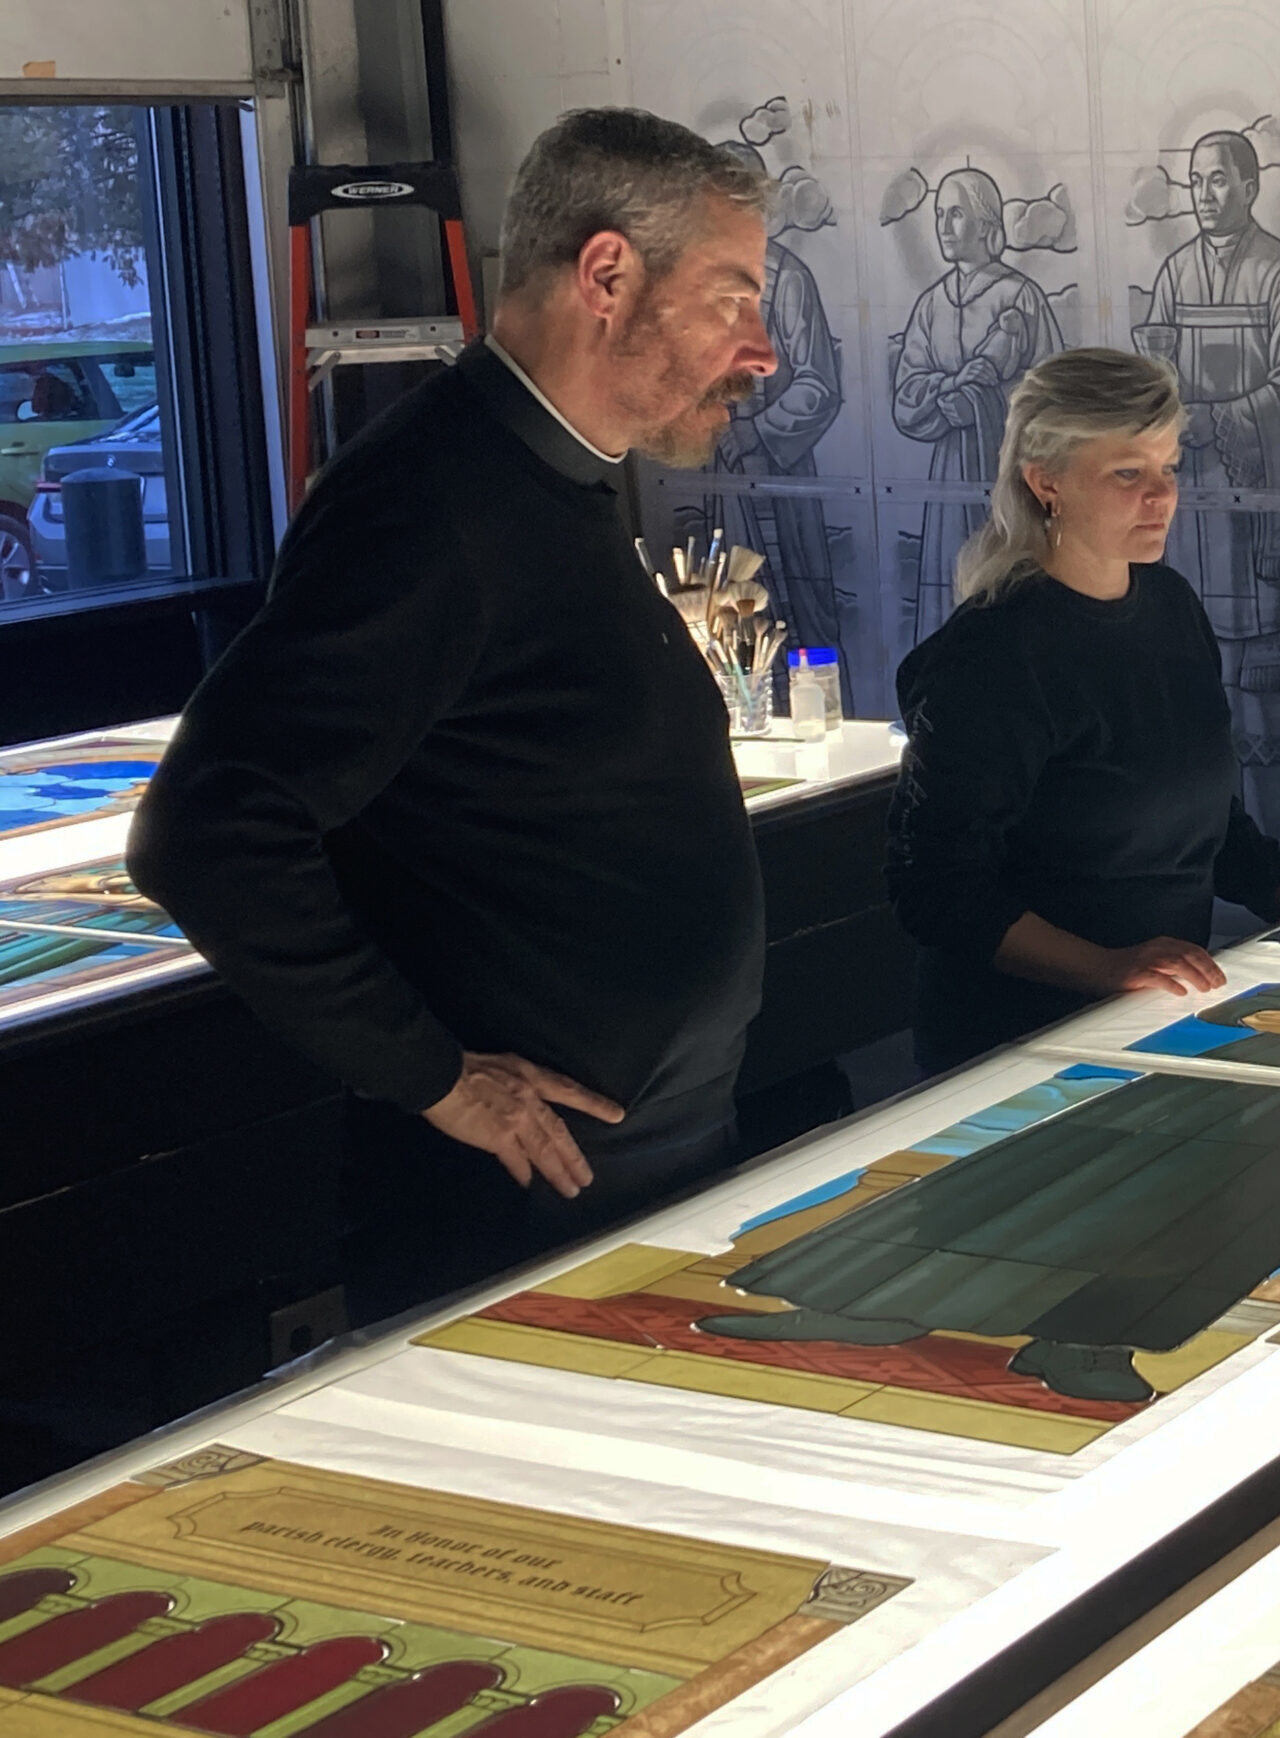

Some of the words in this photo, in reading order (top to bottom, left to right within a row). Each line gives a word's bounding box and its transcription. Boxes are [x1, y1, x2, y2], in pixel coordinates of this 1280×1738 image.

[348, 185, 399, 195] WERNER
[238, 1521, 326, 1543] parish
[518, 1575, 573, 1592] and
[571, 1585, 645, 1605] staff
[403, 1530, 484, 1554] Honor
[480, 1547, 518, 1560] of
[512, 1553, 563, 1570] our
